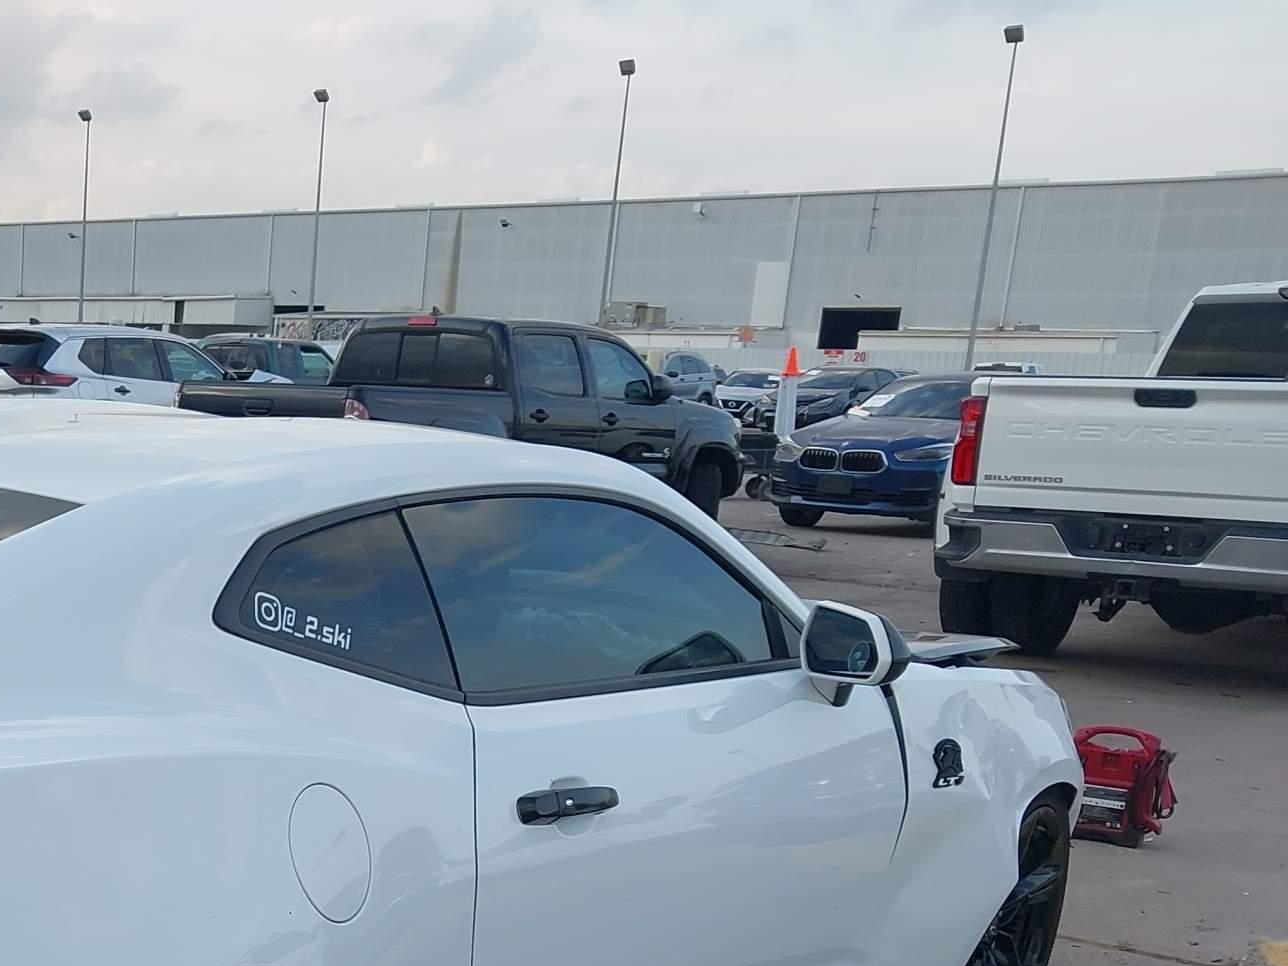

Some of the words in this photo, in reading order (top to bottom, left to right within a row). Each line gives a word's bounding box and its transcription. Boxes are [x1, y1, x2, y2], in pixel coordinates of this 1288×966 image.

[854, 351, 867, 363] 20
[1007, 420, 1288, 448] CHEVROLE
[983, 473, 1064, 484] SILVERADO
